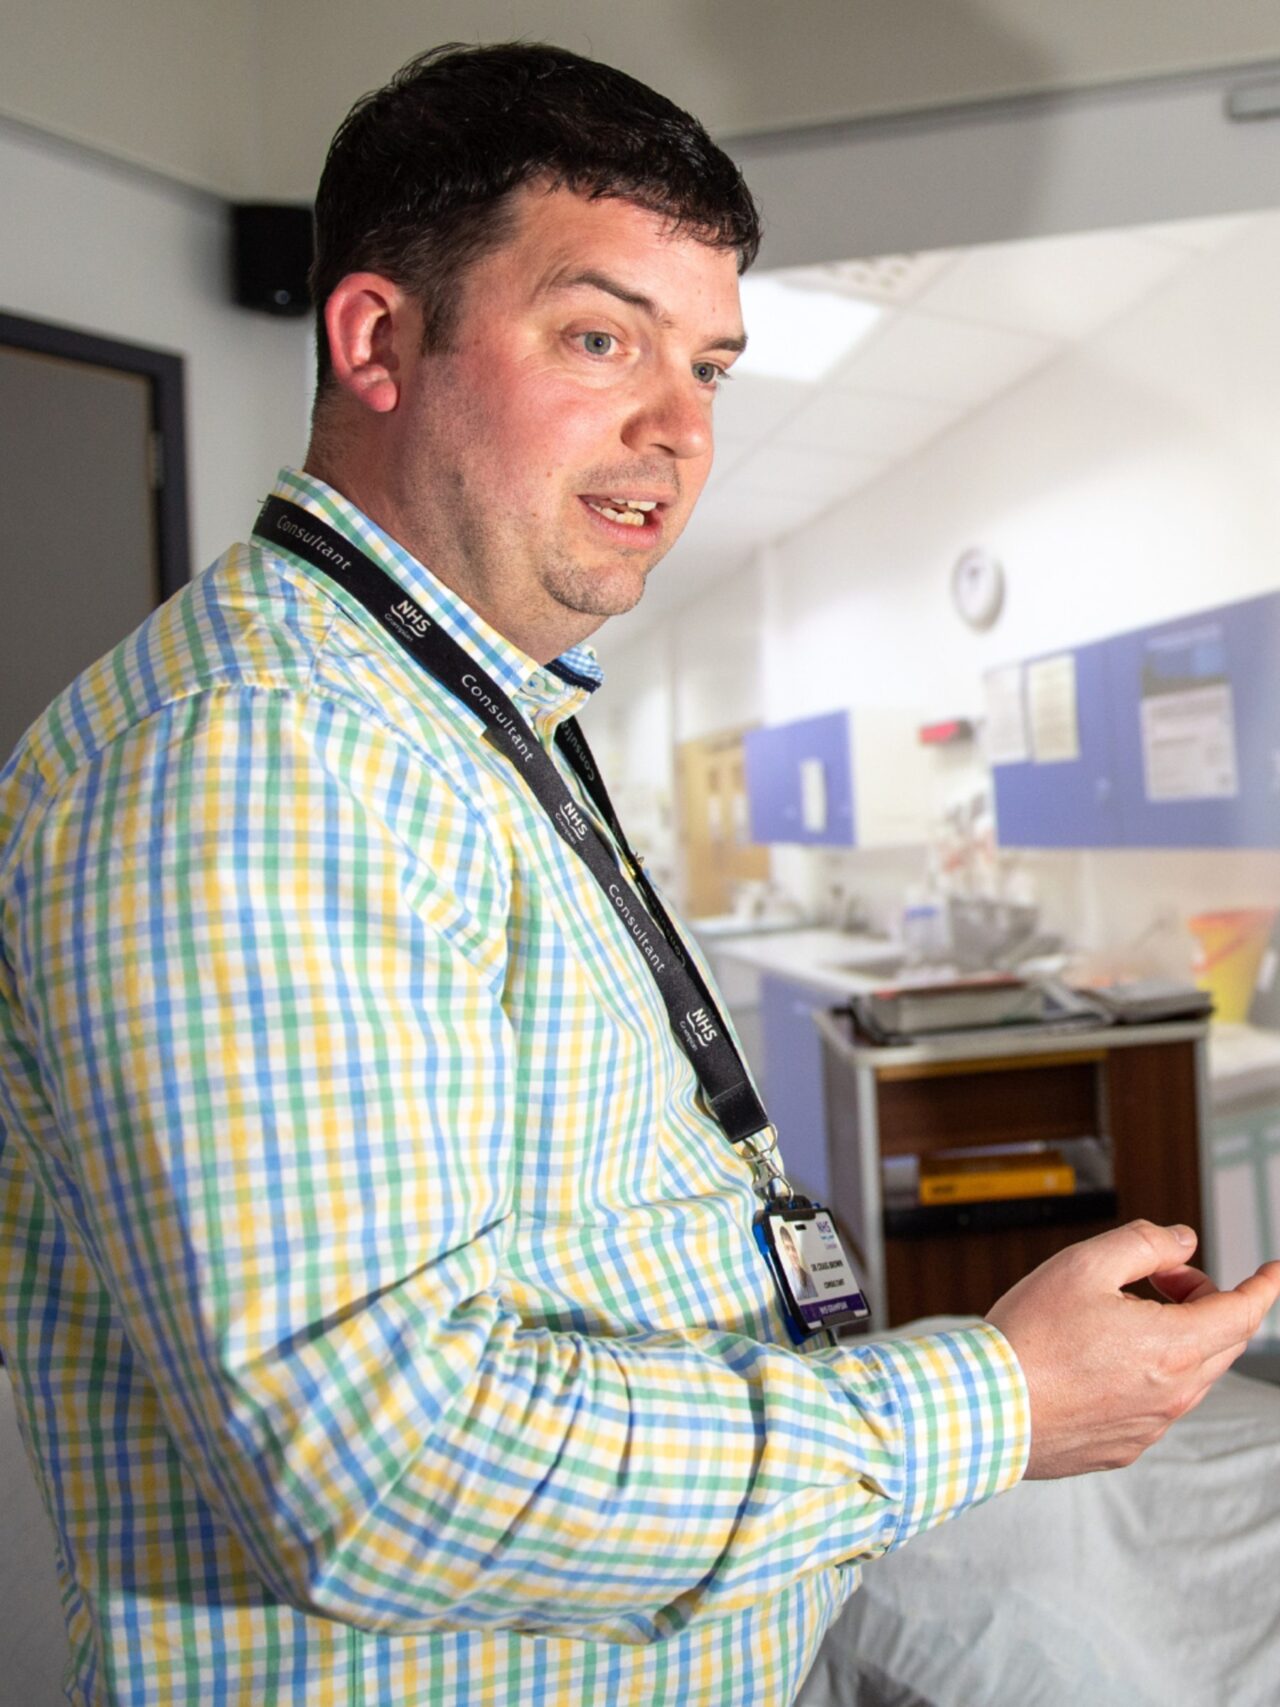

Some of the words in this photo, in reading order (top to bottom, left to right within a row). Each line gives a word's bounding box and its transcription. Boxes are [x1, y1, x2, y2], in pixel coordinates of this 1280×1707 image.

[276, 514, 352, 571] Consultant
[397, 600, 431, 633] NHS
[460, 674, 534, 763] Consultant
[564, 802, 589, 837] NHS
[608, 884, 666, 973] Consultant
[692, 1008, 718, 1042] NHS
[816, 1220, 832, 1233] NHS
